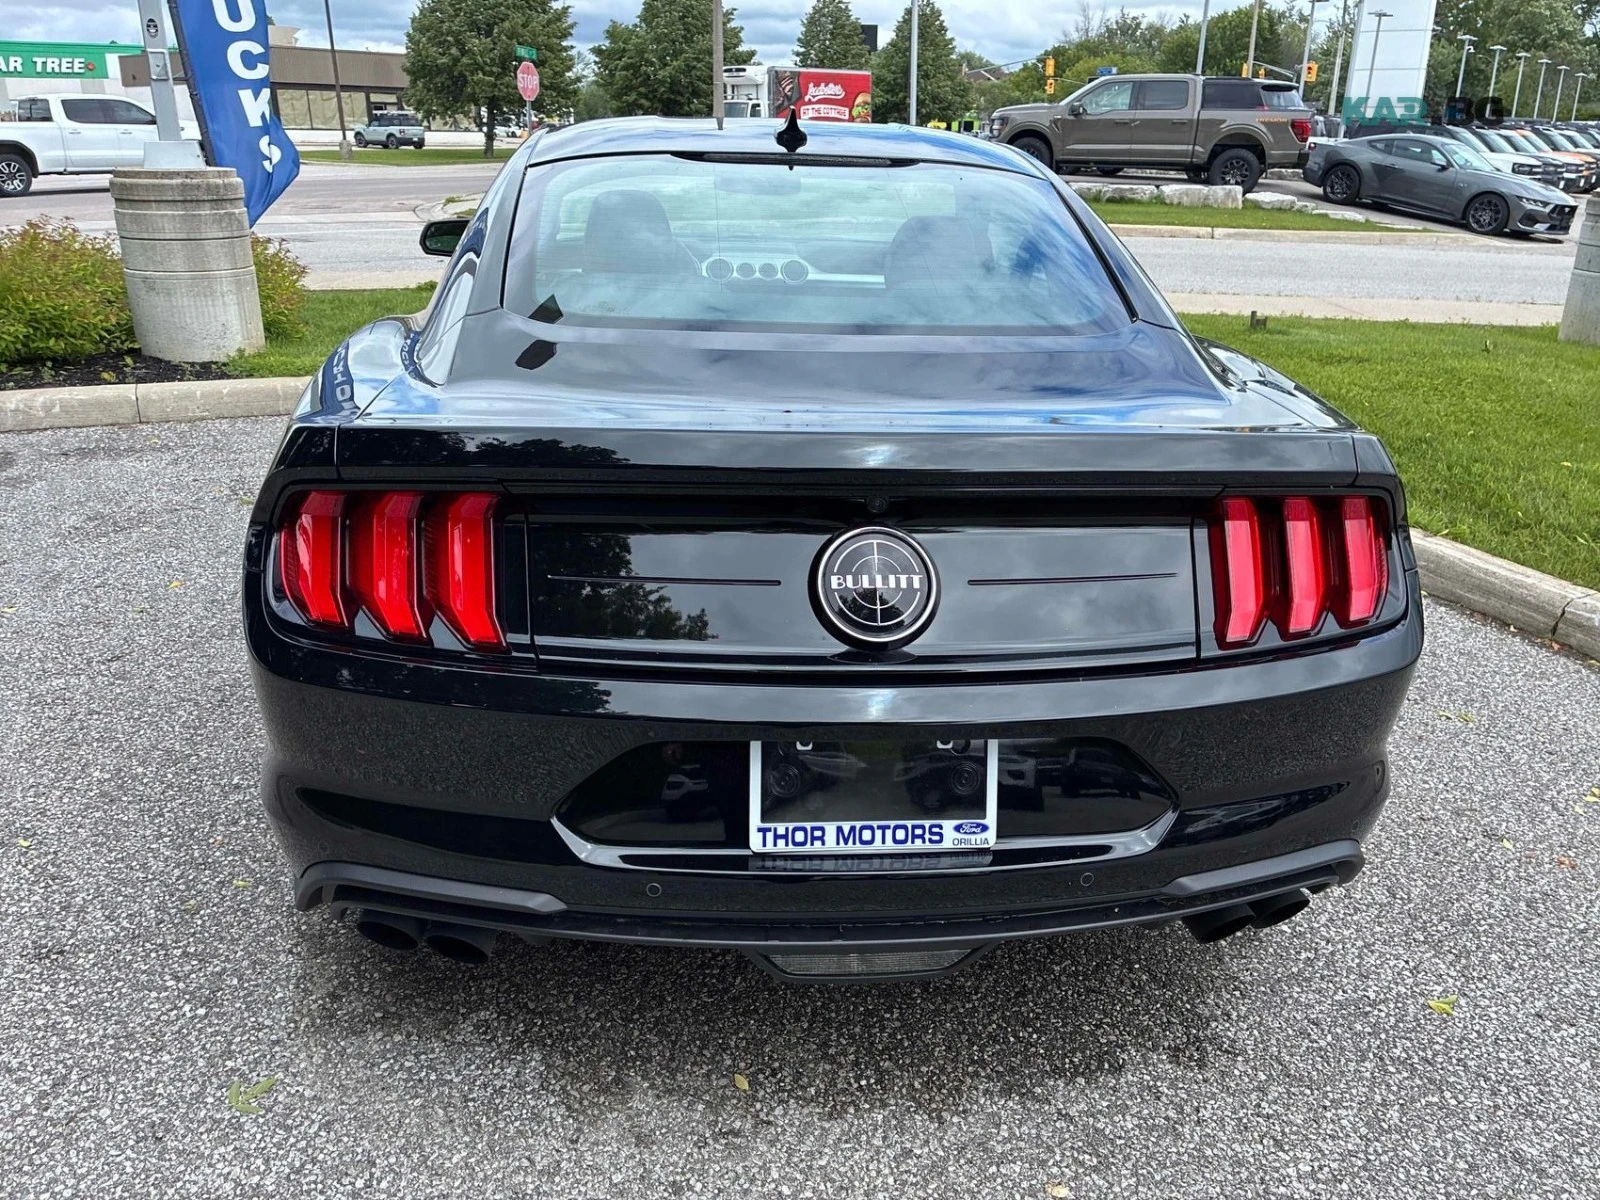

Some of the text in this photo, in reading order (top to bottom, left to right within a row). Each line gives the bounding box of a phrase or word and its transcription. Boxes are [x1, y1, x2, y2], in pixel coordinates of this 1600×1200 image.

[32, 57, 85, 73] TREE
[519, 73, 537, 89] STOP
[803, 106, 847, 117] AT THE COTTAGE
[830, 574, 923, 589] BULLITT
[757, 823, 944, 848] THOR MOTORS
[952, 837, 990, 847] ORILLIA
